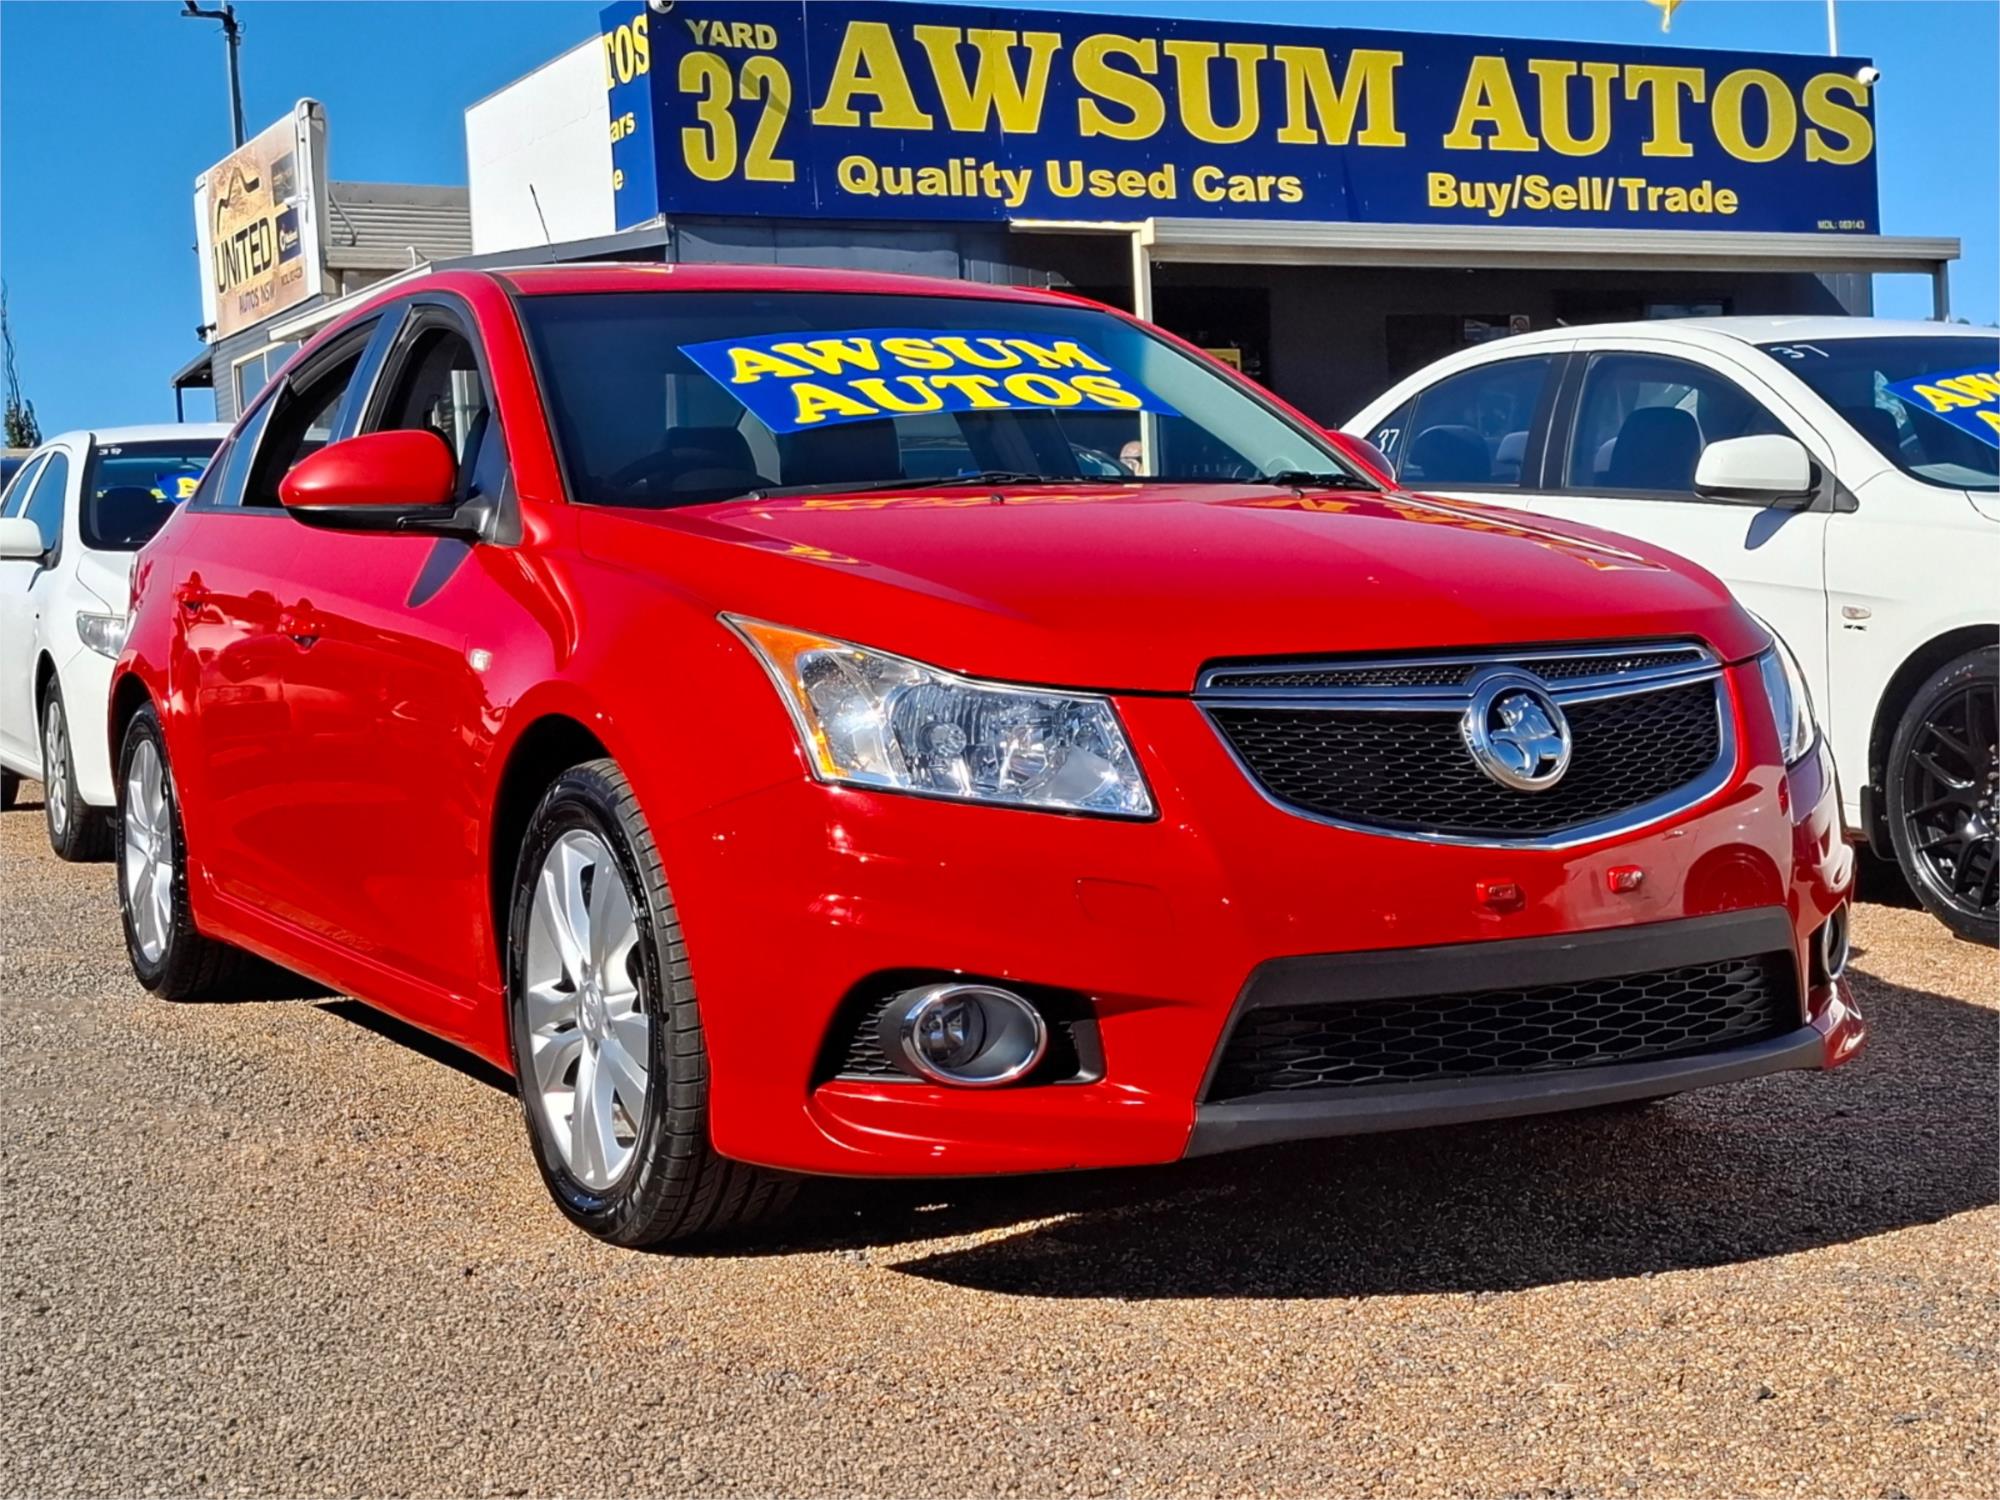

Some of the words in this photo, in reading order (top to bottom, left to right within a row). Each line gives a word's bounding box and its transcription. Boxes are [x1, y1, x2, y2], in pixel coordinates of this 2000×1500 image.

[686, 19, 778, 50] YARD
[811, 19, 1407, 147] AWSUM
[1442, 55, 1873, 165] AUTOS
[678, 51, 796, 183] 32
[837, 155, 1034, 208] Quality
[1045, 159, 1177, 200] Used
[1192, 165, 1304, 204] Cars
[1426, 171, 1739, 218] Buy/Sell/Trade
[214, 216, 273, 294] UNITED
[239, 286, 260, 315] AUTOS
[727, 336, 1111, 384] AWSUM
[1770, 343, 1830, 359] 37
[791, 372, 1143, 424] AUTOS
[1377, 428, 1401, 453] 37
